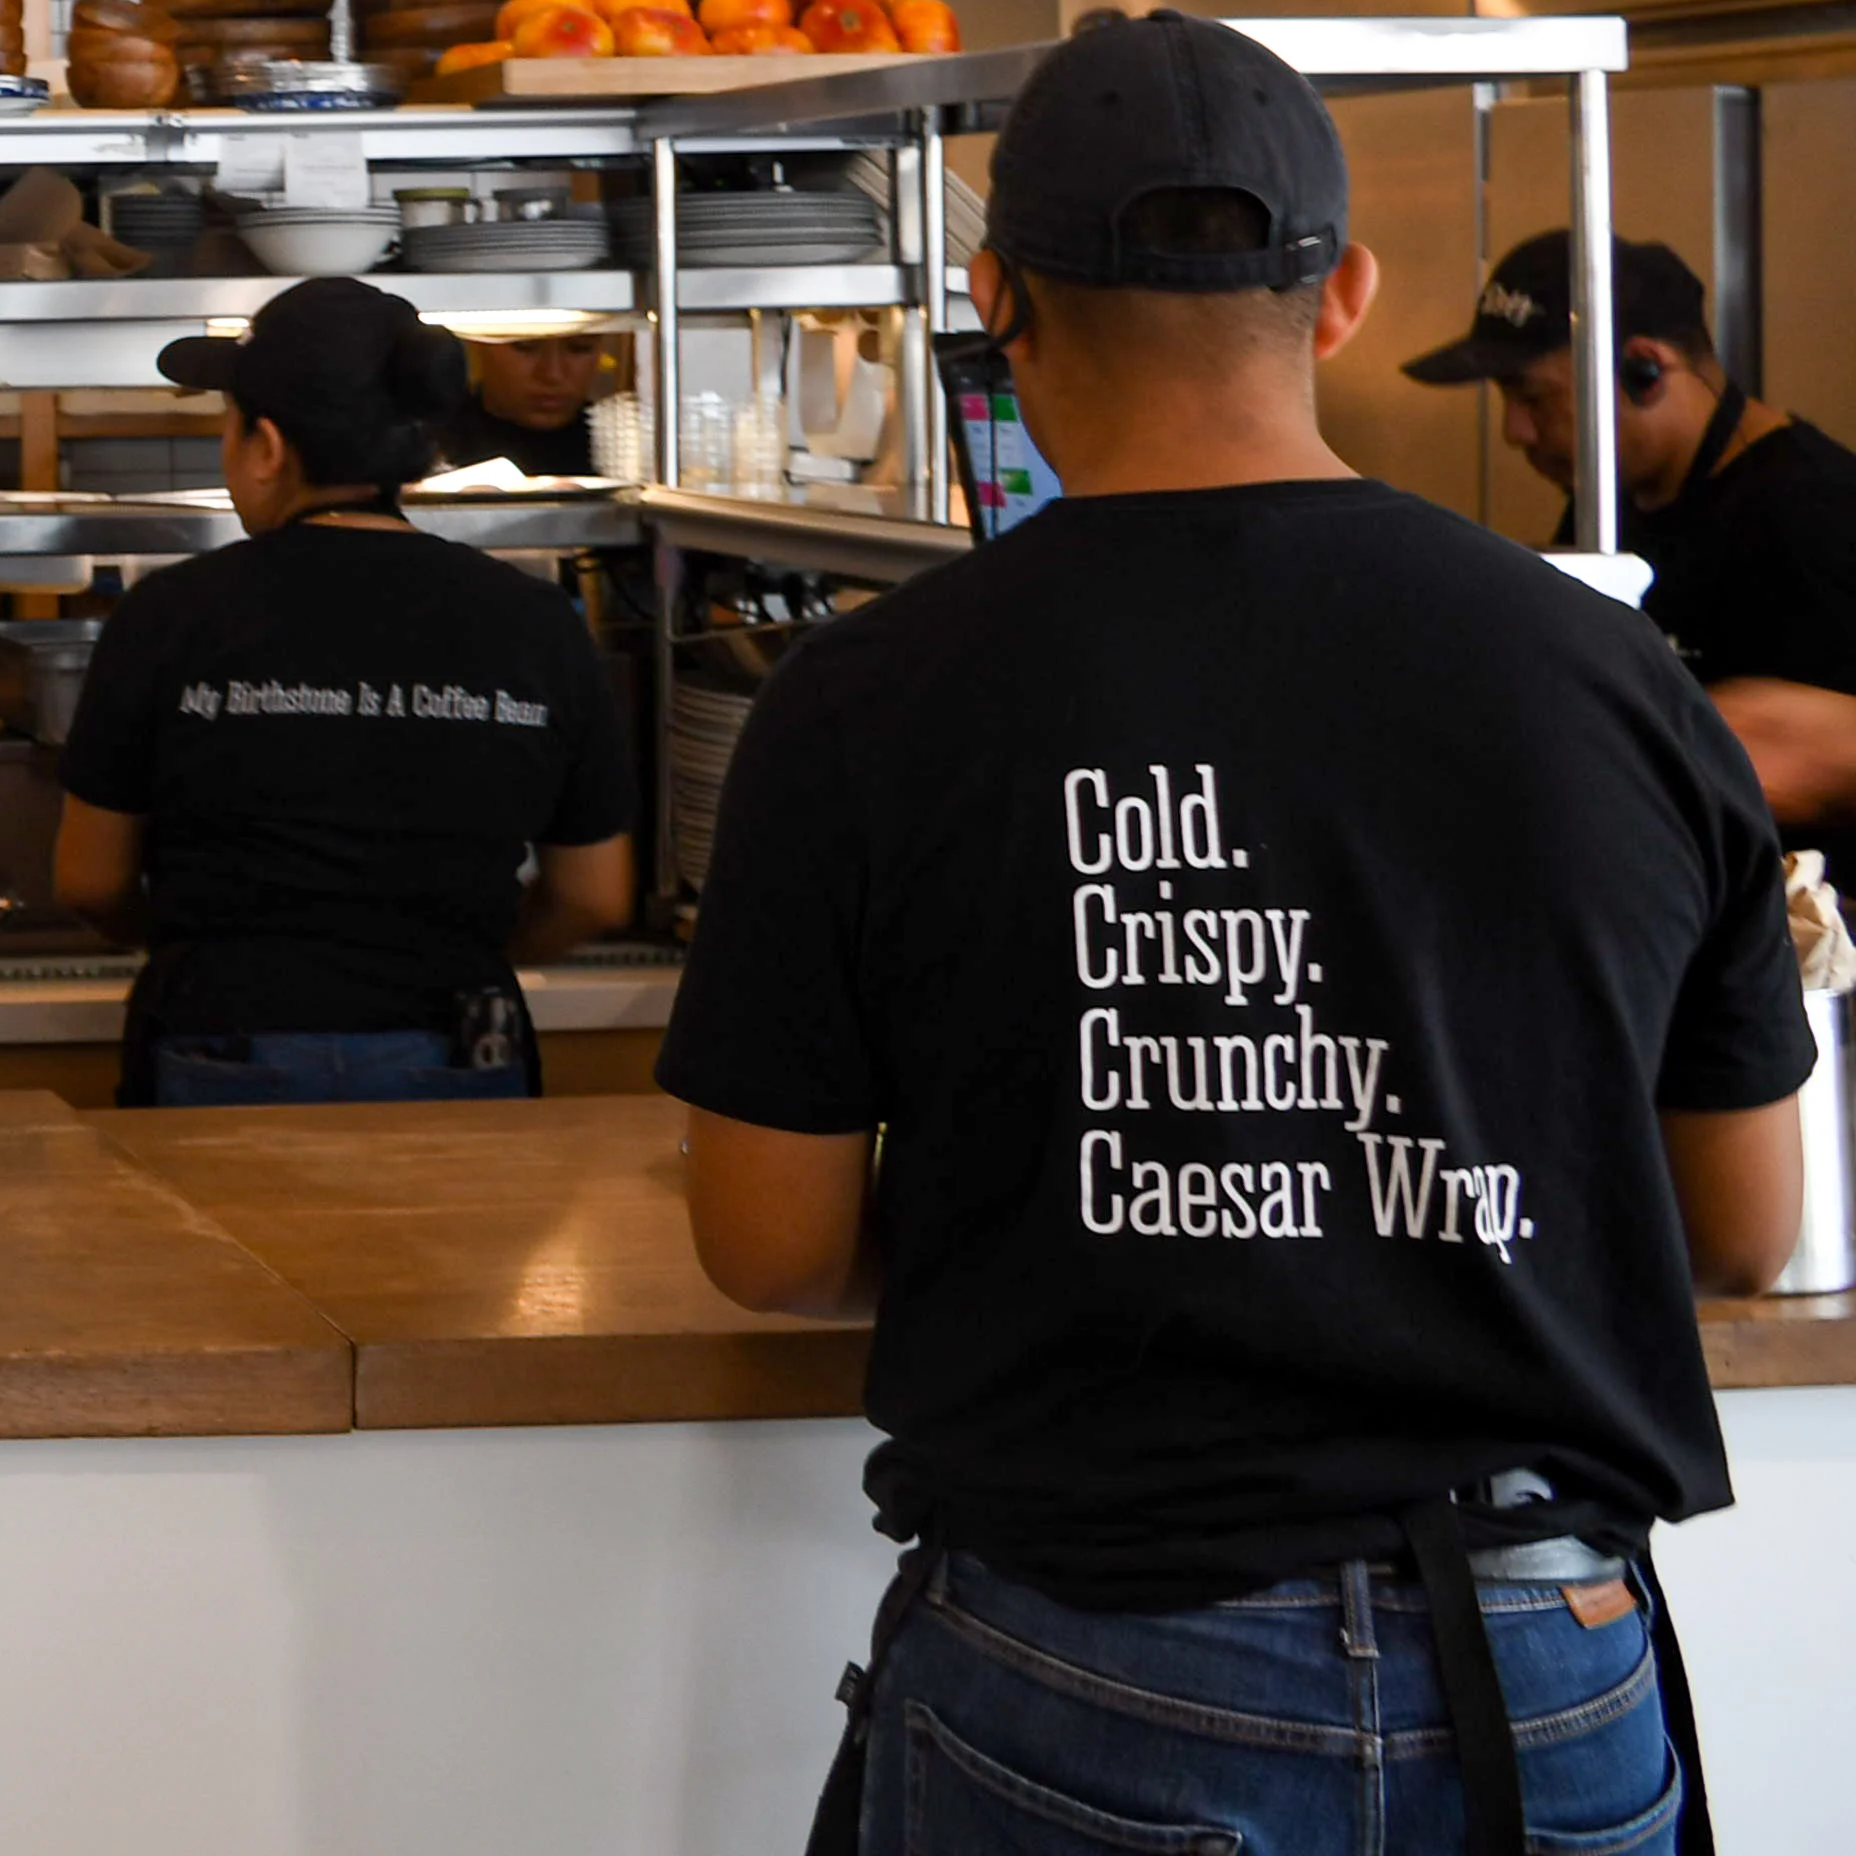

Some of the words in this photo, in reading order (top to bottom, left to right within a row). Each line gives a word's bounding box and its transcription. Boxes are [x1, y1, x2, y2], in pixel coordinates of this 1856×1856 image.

[180, 682, 222, 720] My
[226, 679, 352, 715] Birthstone
[357, 681, 382, 716] Is
[386, 684, 407, 717] A
[412, 684, 490, 721] Coffee
[1063, 764, 1249, 874] Cold.
[1073, 880, 1324, 1005] Crispy.
[1079, 1004, 1402, 1132] Crunchy.
[1080, 1129, 1331, 1239] Caesar
[1357, 1131, 1535, 1264] Wrap.
